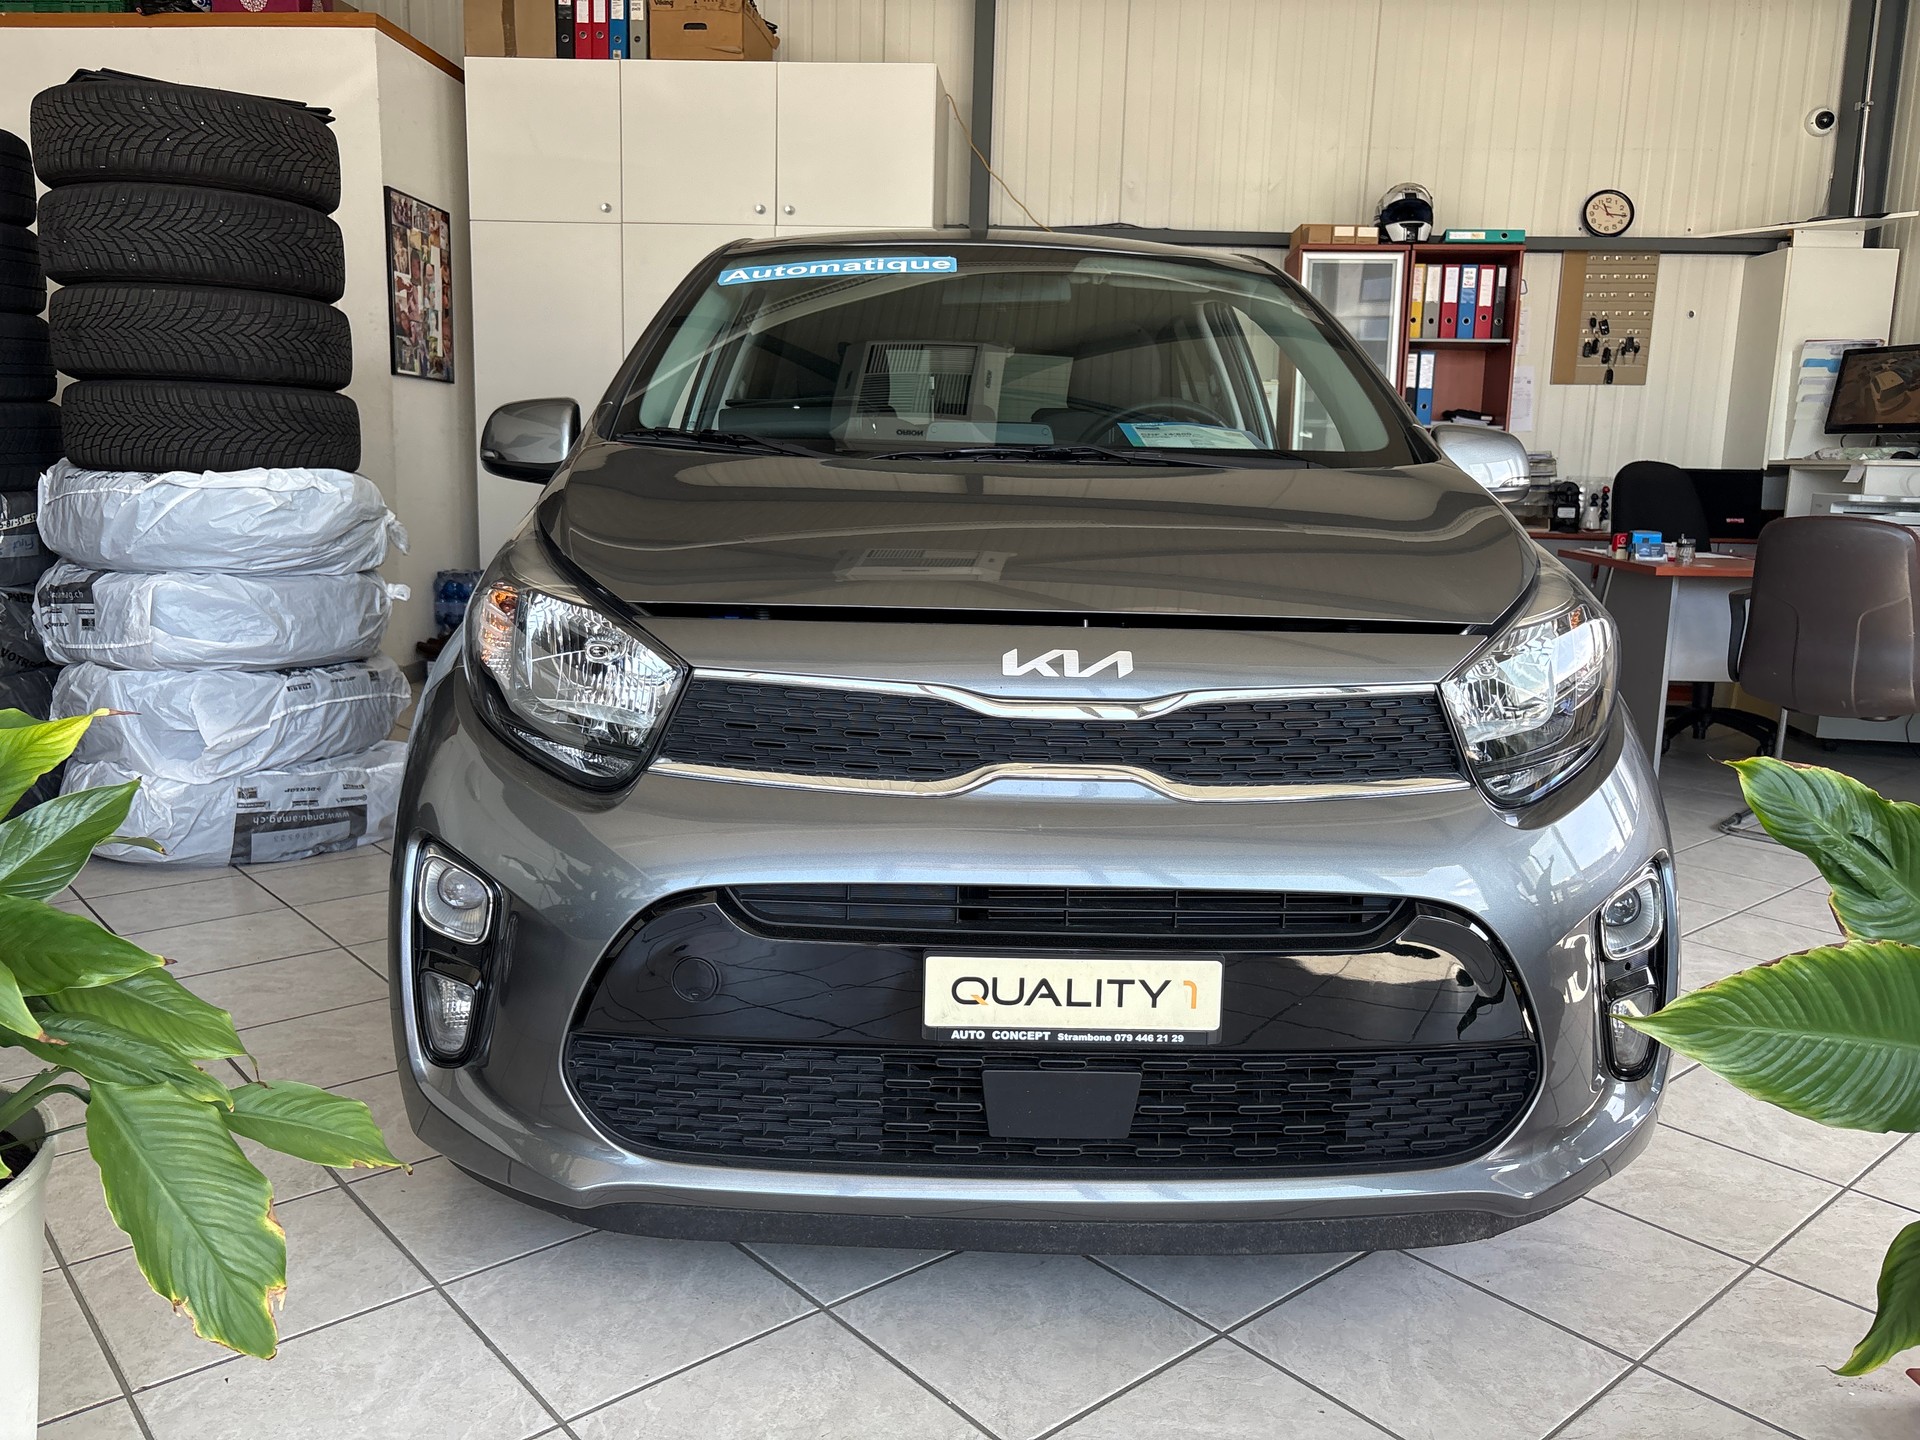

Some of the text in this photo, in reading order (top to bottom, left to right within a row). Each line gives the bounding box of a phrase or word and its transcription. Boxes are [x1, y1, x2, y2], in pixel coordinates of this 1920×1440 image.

[723, 257, 951, 283] Automatique
[1002, 648, 1134, 679] KIA
[951, 976, 1198, 1009] QUALITY 1
[951, 1030, 1185, 1043] AUTO CONCEPT Strambone 079 446 21 29
